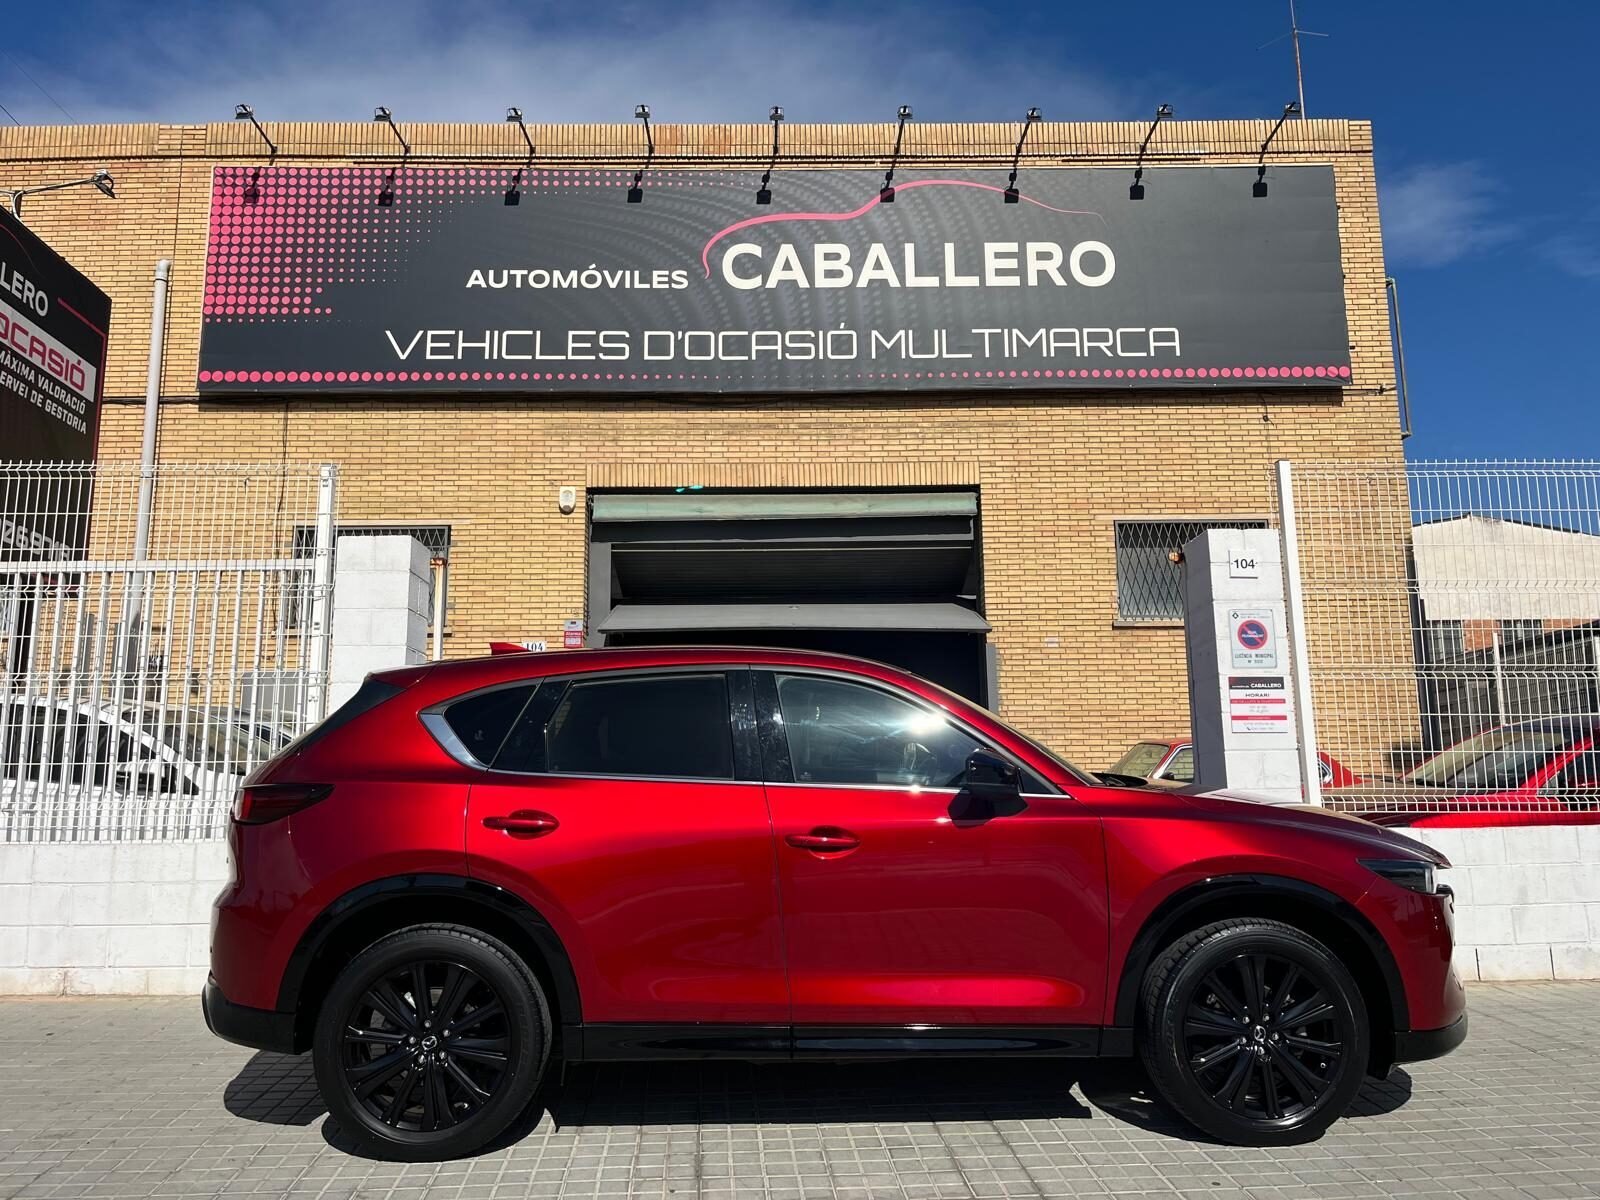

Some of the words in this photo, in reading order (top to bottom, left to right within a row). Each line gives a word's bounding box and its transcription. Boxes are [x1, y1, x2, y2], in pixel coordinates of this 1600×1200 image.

[466, 263, 689, 289] AUTOMÓVILES
[722, 240, 1117, 290] CABALLERO
[385, 329, 630, 360] VEHICLES
[643, 322, 858, 361] D'OCASIÓ
[872, 327, 1181, 360] MULTIMARCA
[30, 390, 44, 408] DE
[45, 399, 87, 435] GESTORIA
[38, 373, 86, 415] VALORACIÓ
[1233, 558, 1256, 569] 104
[526, 642, 543, 652] 104
